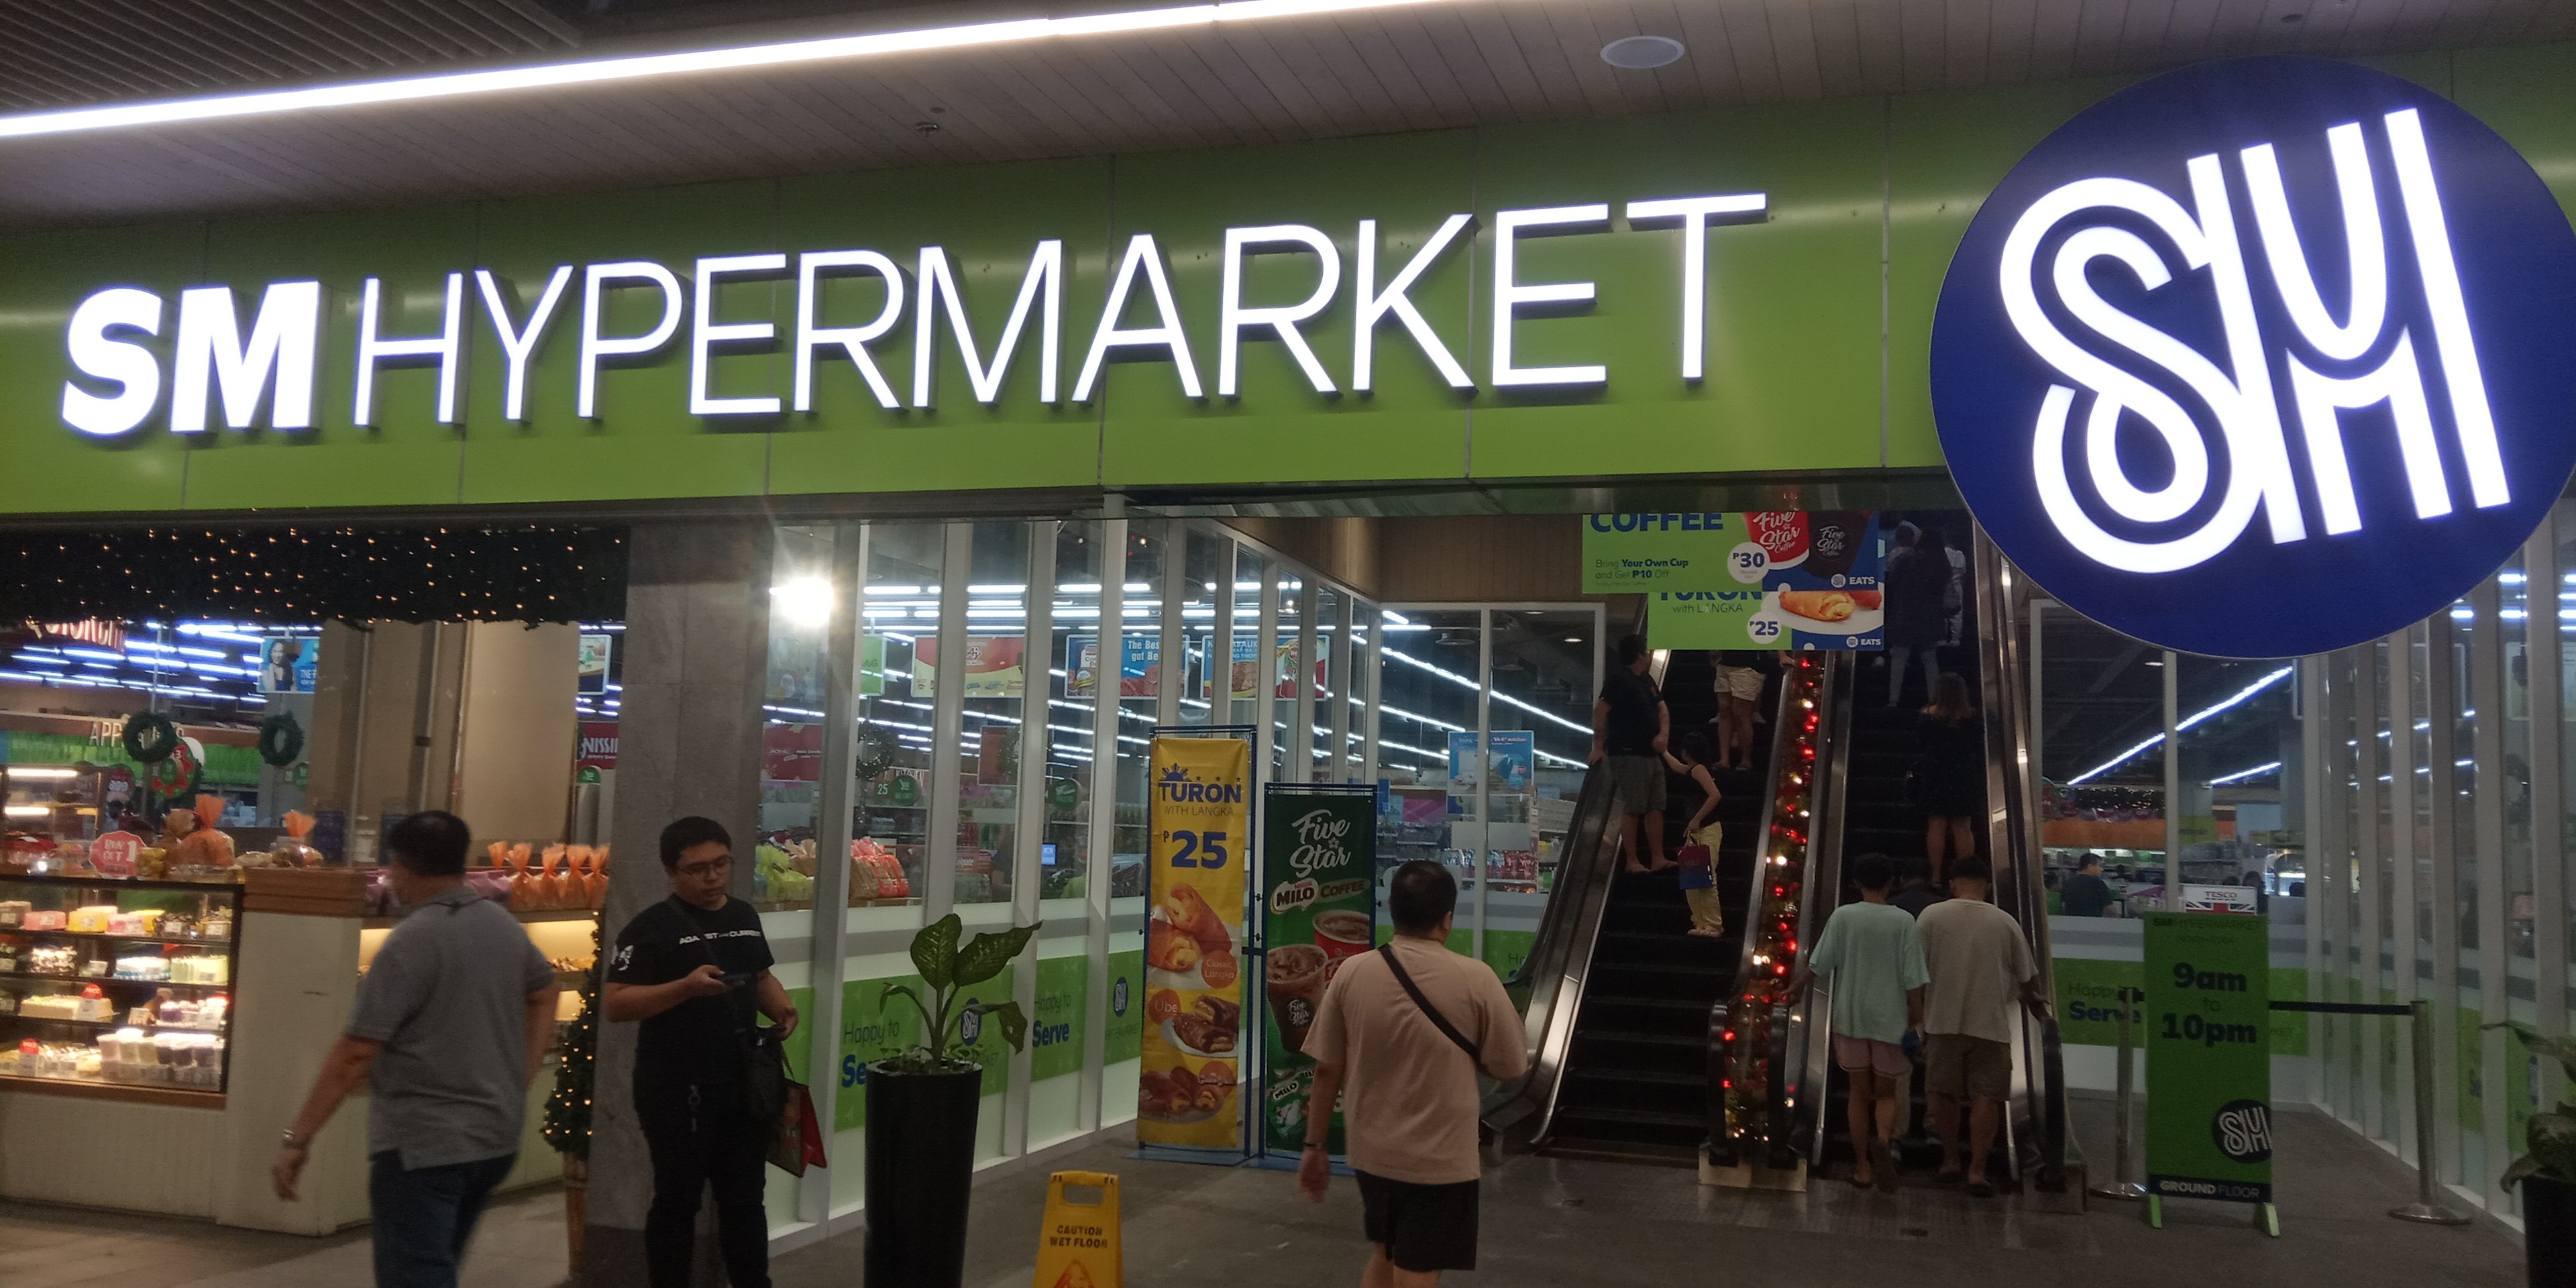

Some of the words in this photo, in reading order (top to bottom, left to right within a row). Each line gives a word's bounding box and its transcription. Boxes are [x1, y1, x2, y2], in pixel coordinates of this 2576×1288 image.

[62, 280, 321, 435] SM
[354, 192, 1767, 427] HYPERMARKET
[2000, 107, 2512, 574] SM
[1621, 559, 1644, 568] Your
[1644, 558, 1668, 567] Own
[1670, 557, 1688, 568] Cup
[1632, 570, 1653, 578] P10
[1849, 576, 1875, 585] EATS
[1673, 604, 1695, 613] with
[1697, 603, 1743, 613] LANGKA
[1128, 641, 1142, 650] The
[877, 783, 888, 795] 25
[1159, 782, 1242, 804] TURON
[1164, 805, 1189, 816] WITH
[1192, 806, 1234, 816] LANGKA
[1291, 809, 1350, 845] Five
[1289, 843, 1352, 879] Star
[1276, 887, 1315, 907] MILO
[2205, 891, 2237, 899] TESCO
[2173, 962, 2247, 992] 9am
[1155, 1000, 1177, 1013] Ube
[844, 1022, 885, 1047] Happy
[888, 1020, 900, 1037] to
[1032, 1020, 1070, 1048] Serve
[2161, 1012, 2257, 1049] 10pm
[2159, 1179, 2216, 1195] GROUND
[2219, 1183, 2261, 1198] FLOOR
[1057, 1224, 1103, 1236] CAUTION
[1049, 1236, 1071, 1247] WET
[1073, 1238, 1108, 1249] FLOOR
